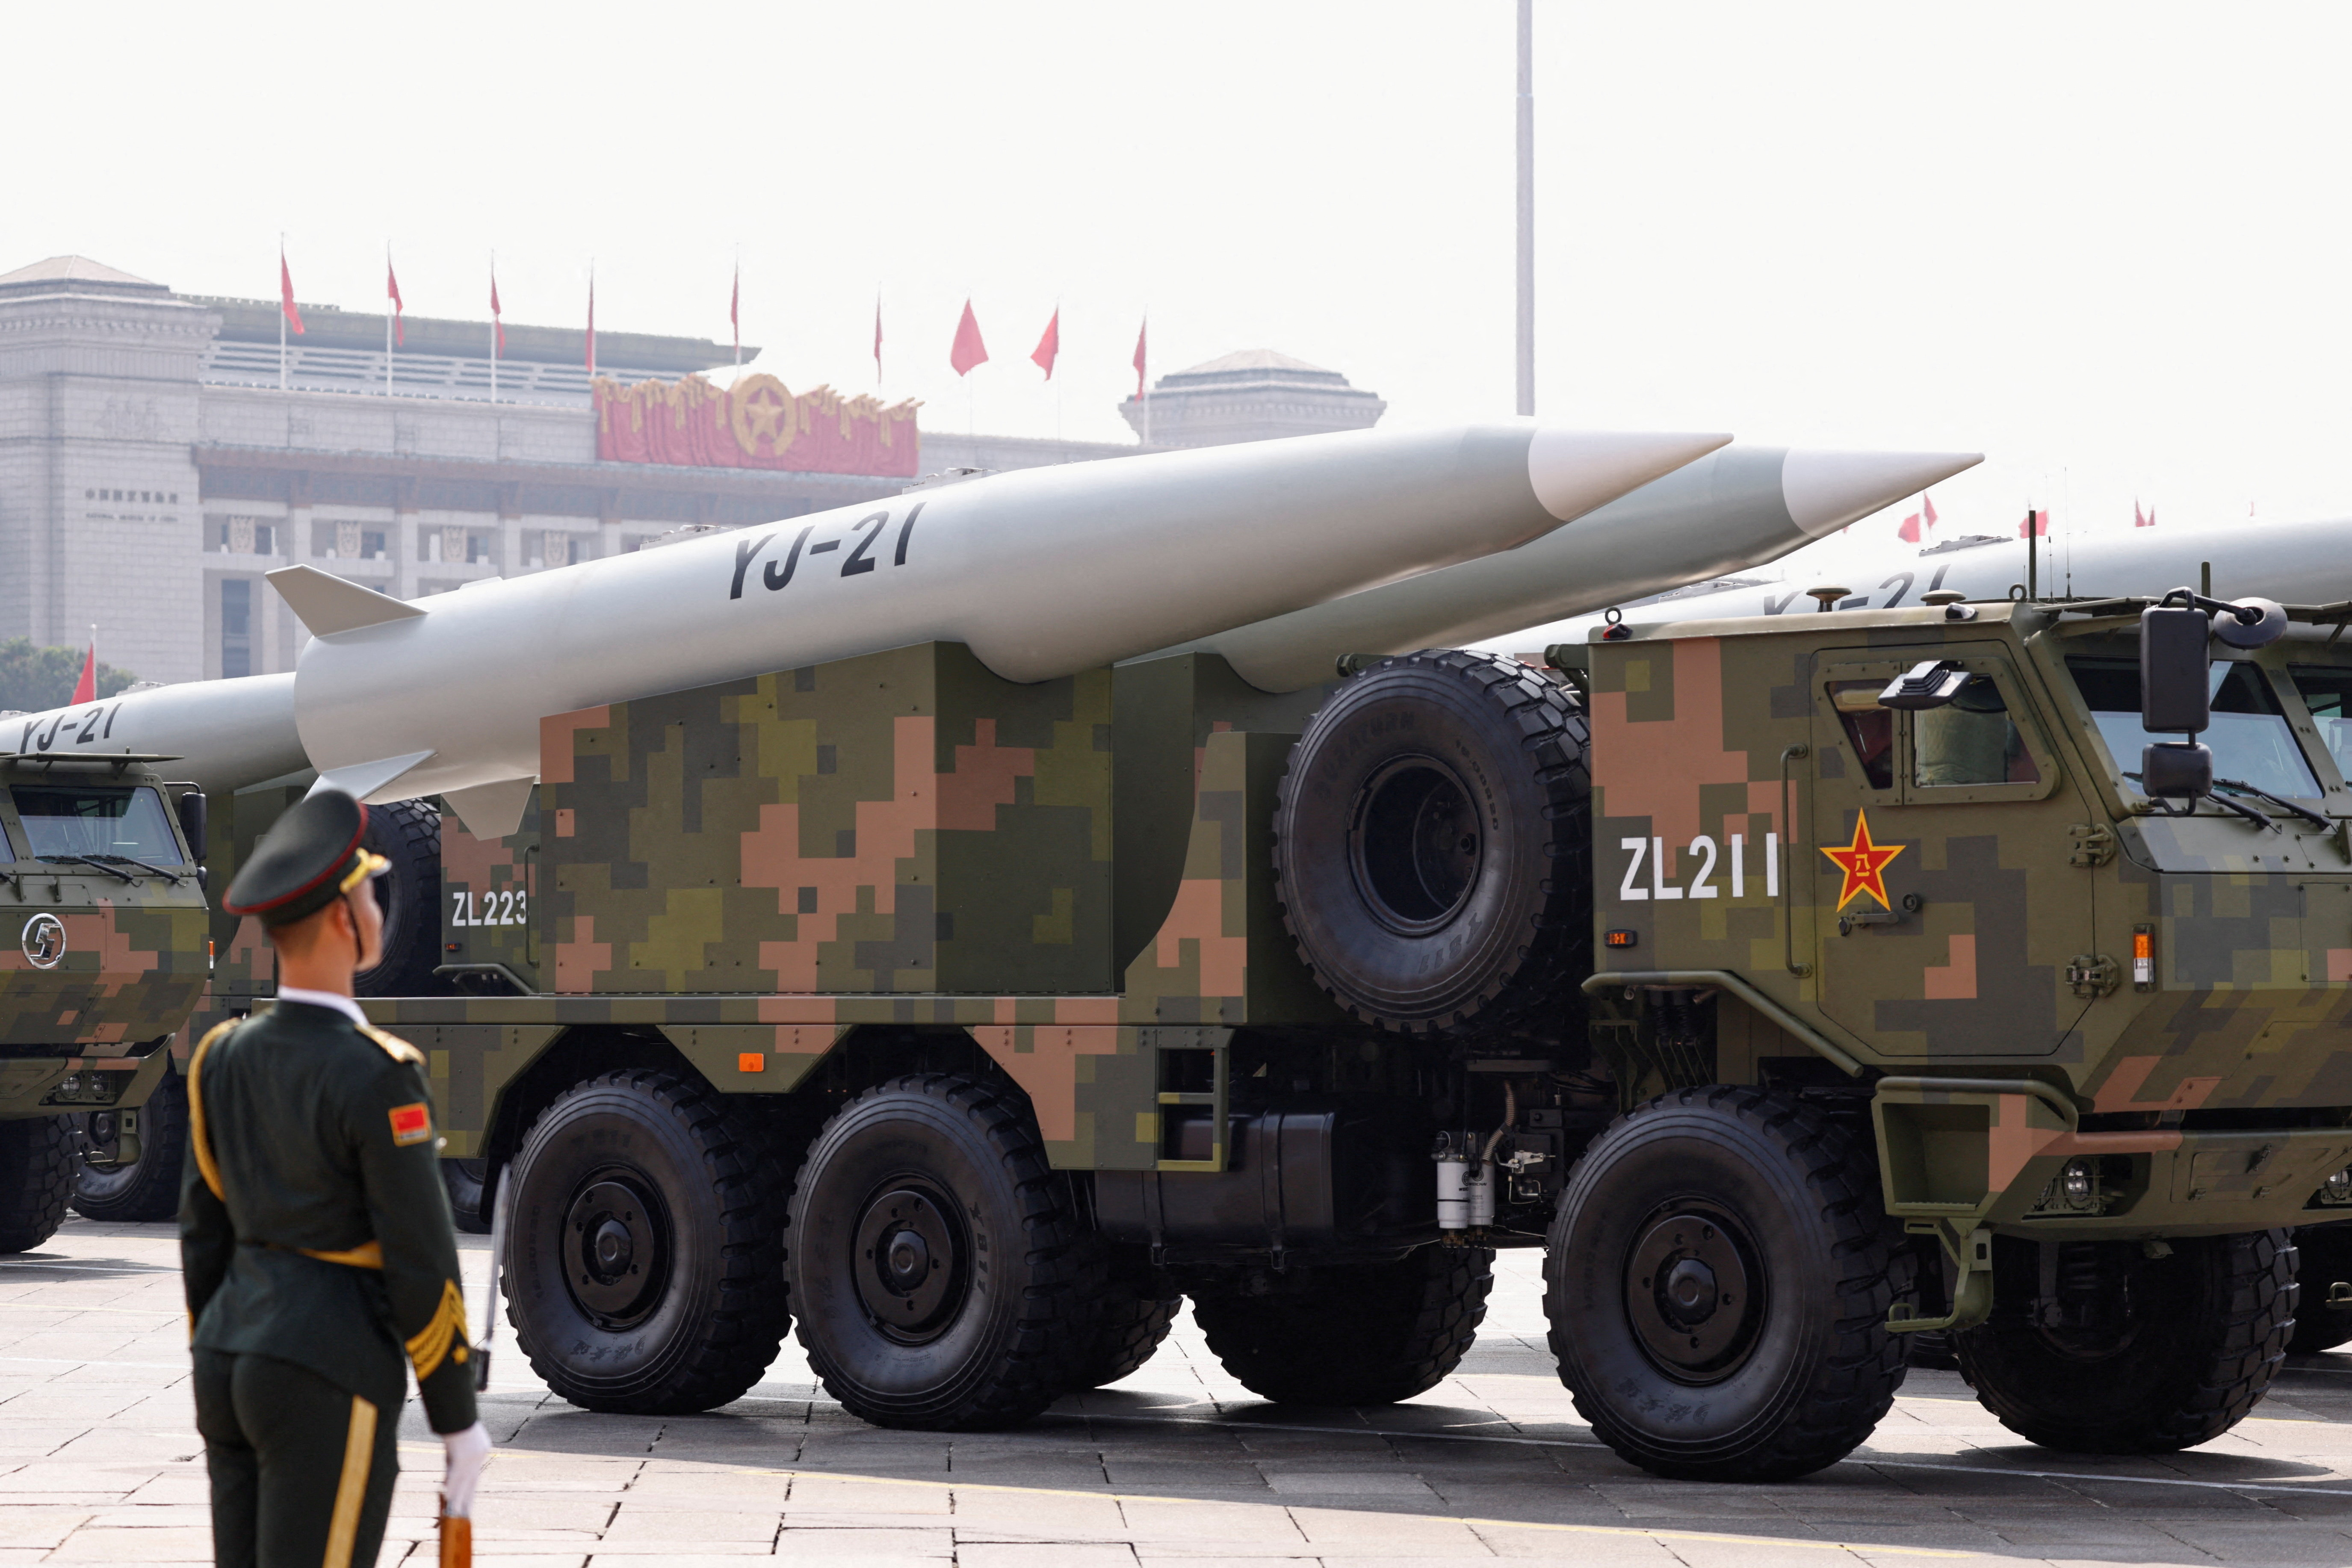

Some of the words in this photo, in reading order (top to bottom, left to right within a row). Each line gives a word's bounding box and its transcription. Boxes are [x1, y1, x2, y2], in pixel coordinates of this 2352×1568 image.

[730, 502, 925, 600] YJ-21
[1764, 564, 1951, 615] Y-21
[20, 703, 123, 754] YJ-21
[1620, 833, 1778, 901] ZL211
[1855, 853, 1870, 877] 八一
[452, 890, 530, 927] ZL223
